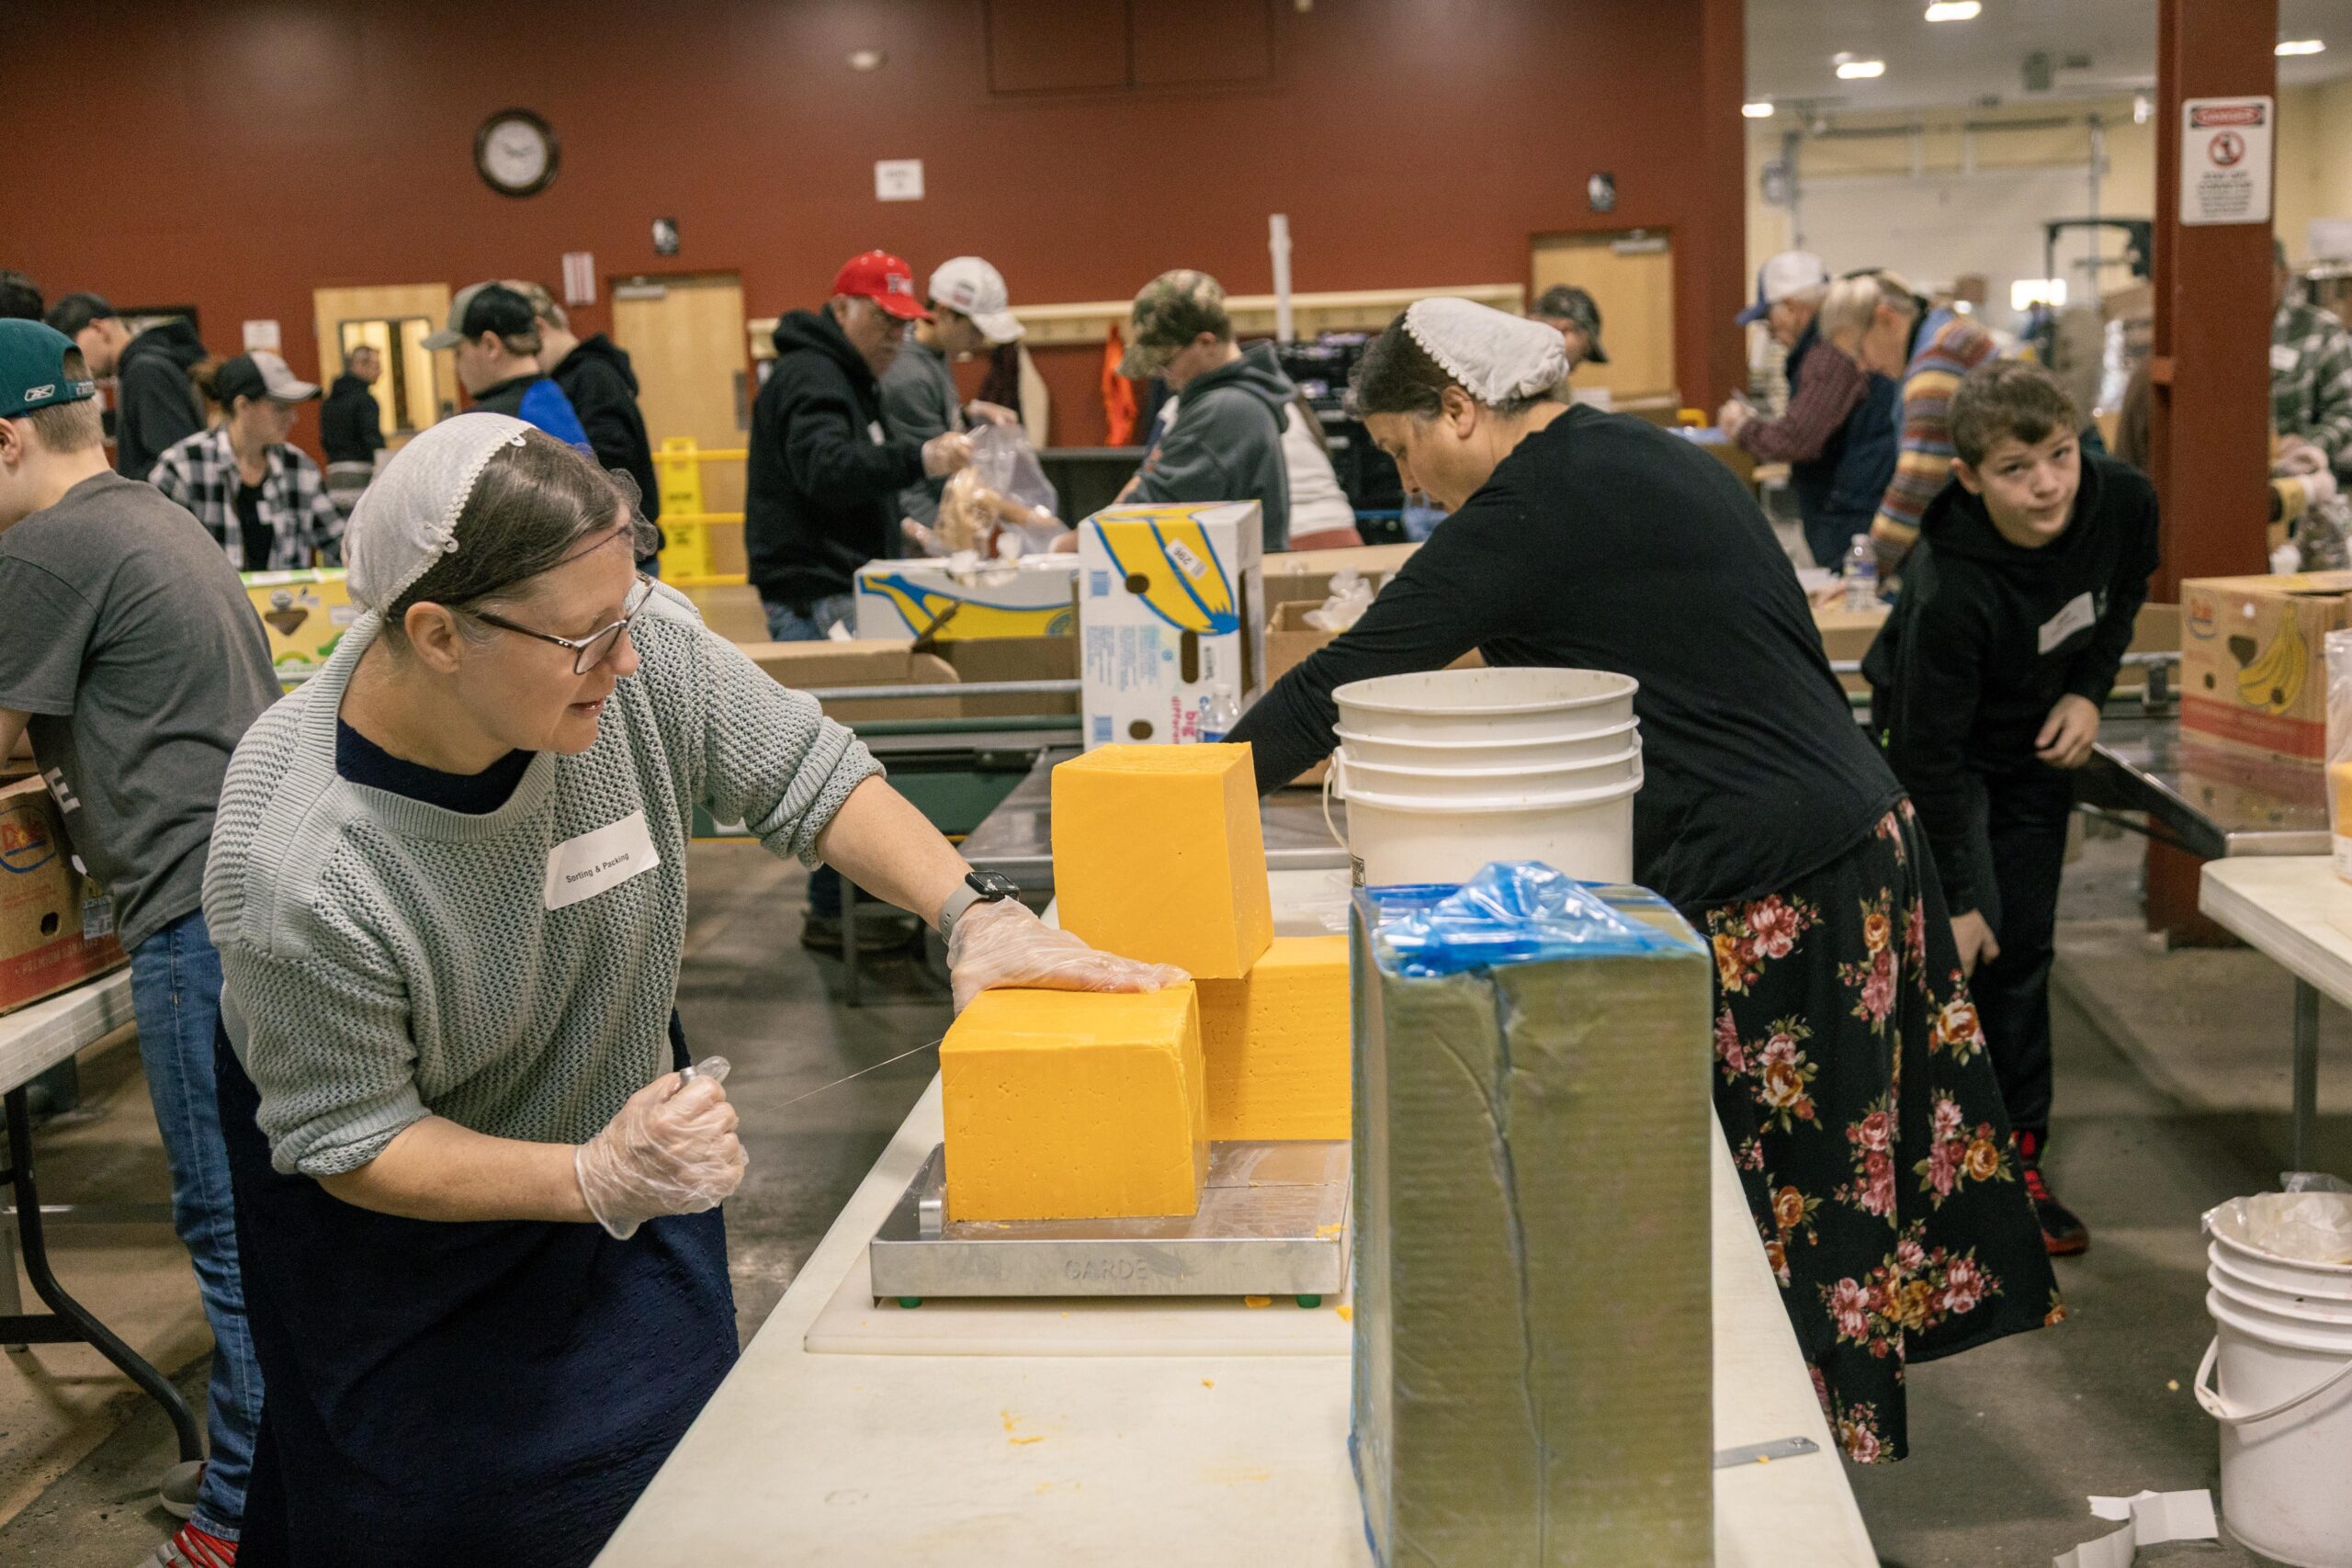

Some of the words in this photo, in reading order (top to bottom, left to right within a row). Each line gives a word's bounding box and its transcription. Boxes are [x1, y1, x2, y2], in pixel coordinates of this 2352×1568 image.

[566, 868, 594, 884] Sorting
[603, 852, 629, 870] Packing
[1064, 1258, 1148, 1280] GARDE
